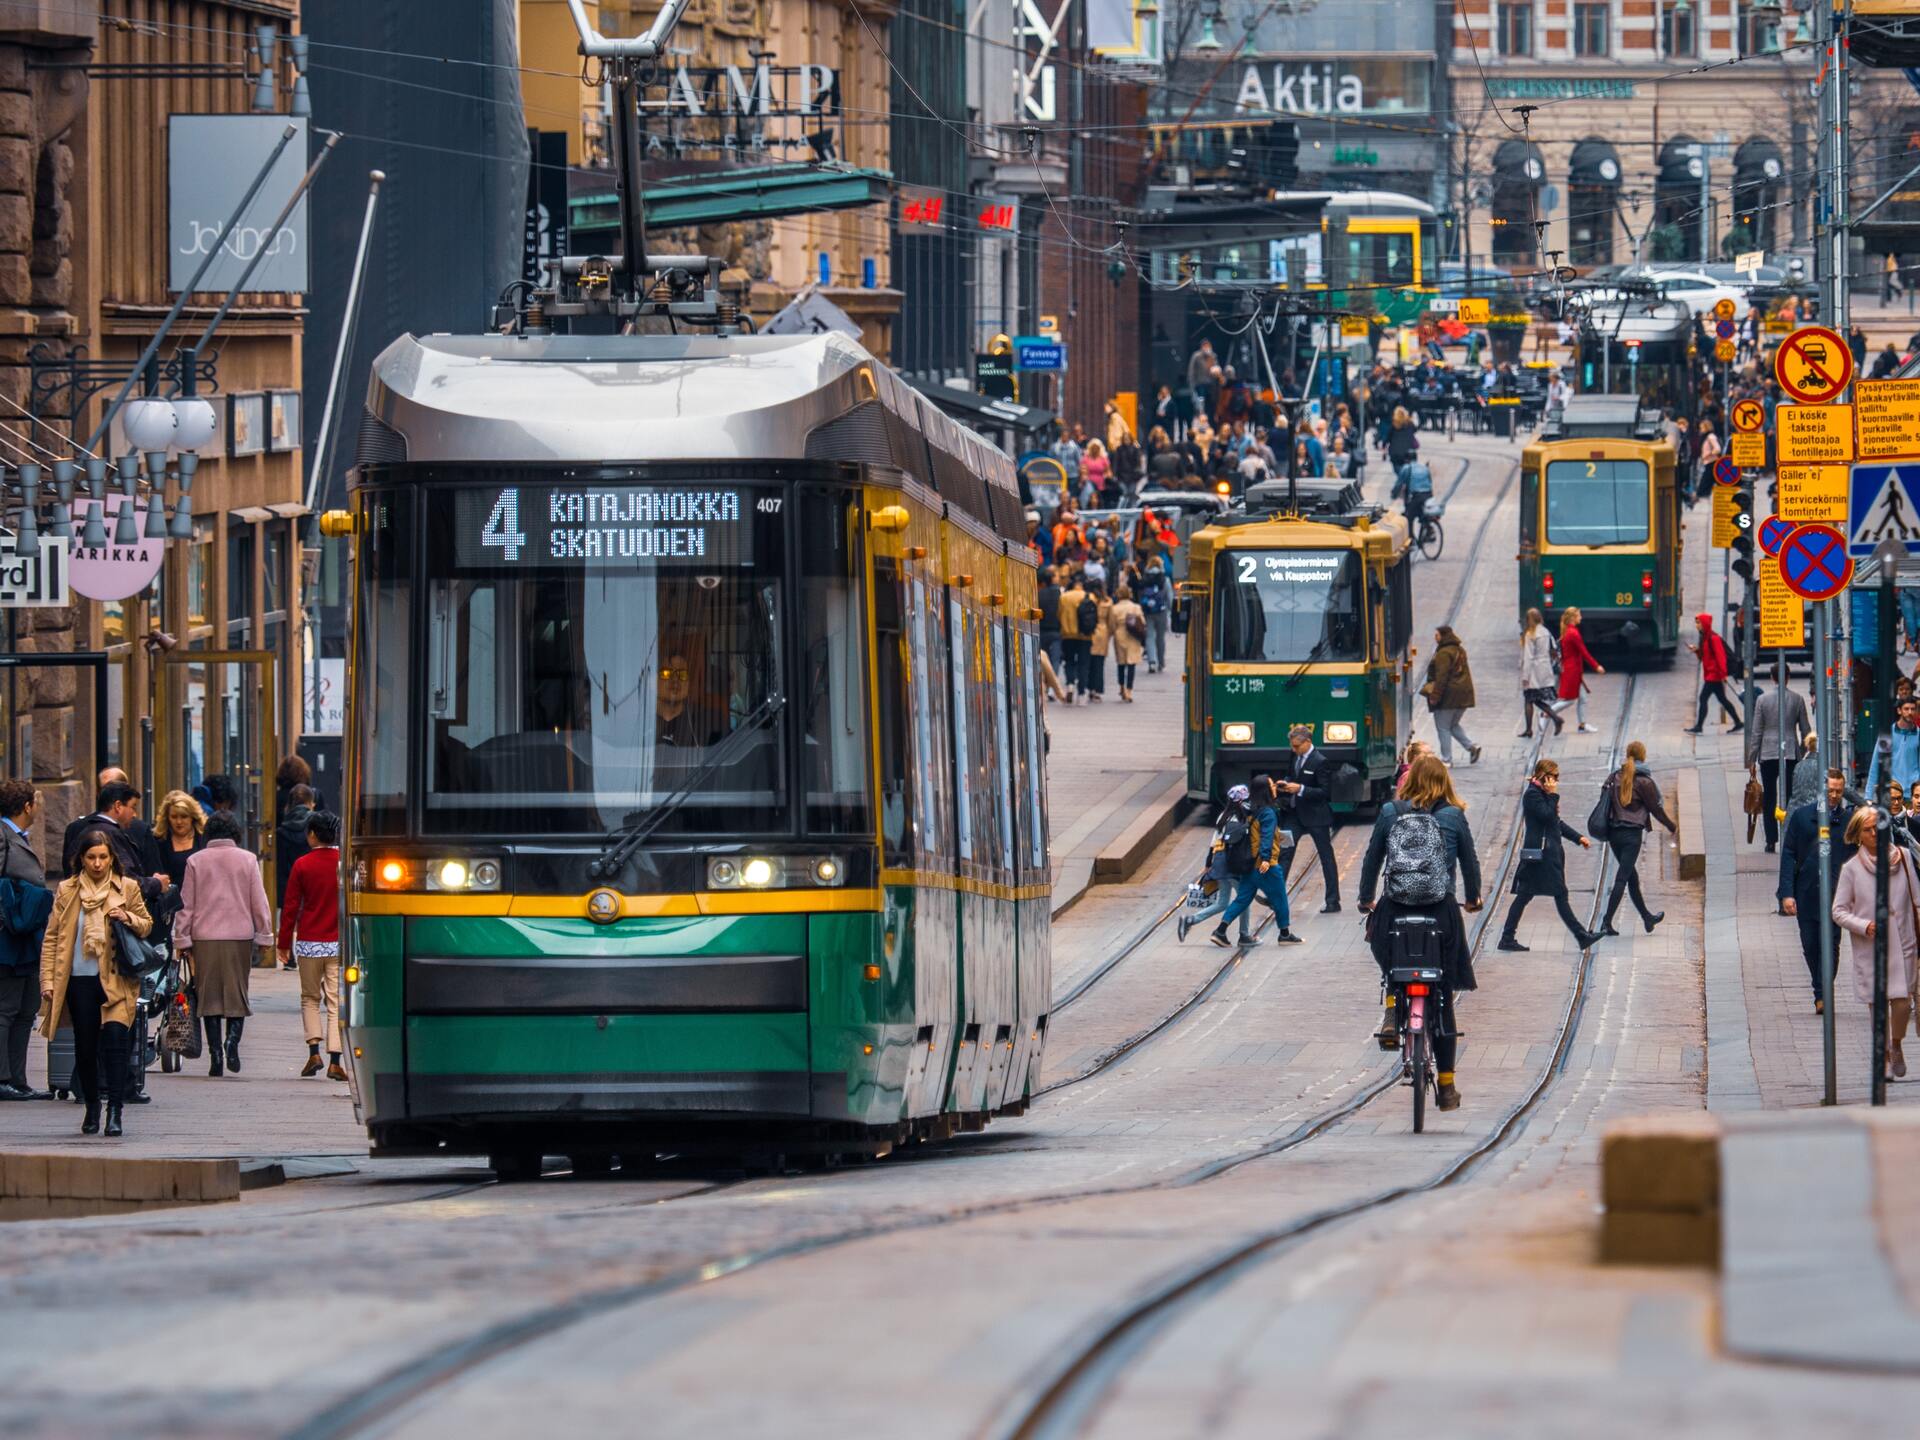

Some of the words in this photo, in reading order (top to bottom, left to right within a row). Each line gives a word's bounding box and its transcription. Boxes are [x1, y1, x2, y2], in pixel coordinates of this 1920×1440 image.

[1235, 64, 1363, 113] Aktia
[1574, 80, 1633, 99] HOUSE
[647, 133, 811, 151] ALLERIA
[1787, 410, 1796, 420] Ei
[1800, 410, 1827, 420] koske
[1585, 462, 1597, 478] 2
[1780, 470, 1806, 480] Gäller
[1811, 470, 1820, 481] ej
[756, 498, 783, 513] 407
[482, 488, 526, 560] 4
[549, 492, 740, 523] KATAJANOKKA
[549, 527, 705, 557] SKATUDDEN
[1238, 556, 1257, 583] 2
[1269, 571, 1284, 581] via
[1285, 571, 1332, 583] Kauppatori
[1615, 592, 1633, 605] 89
